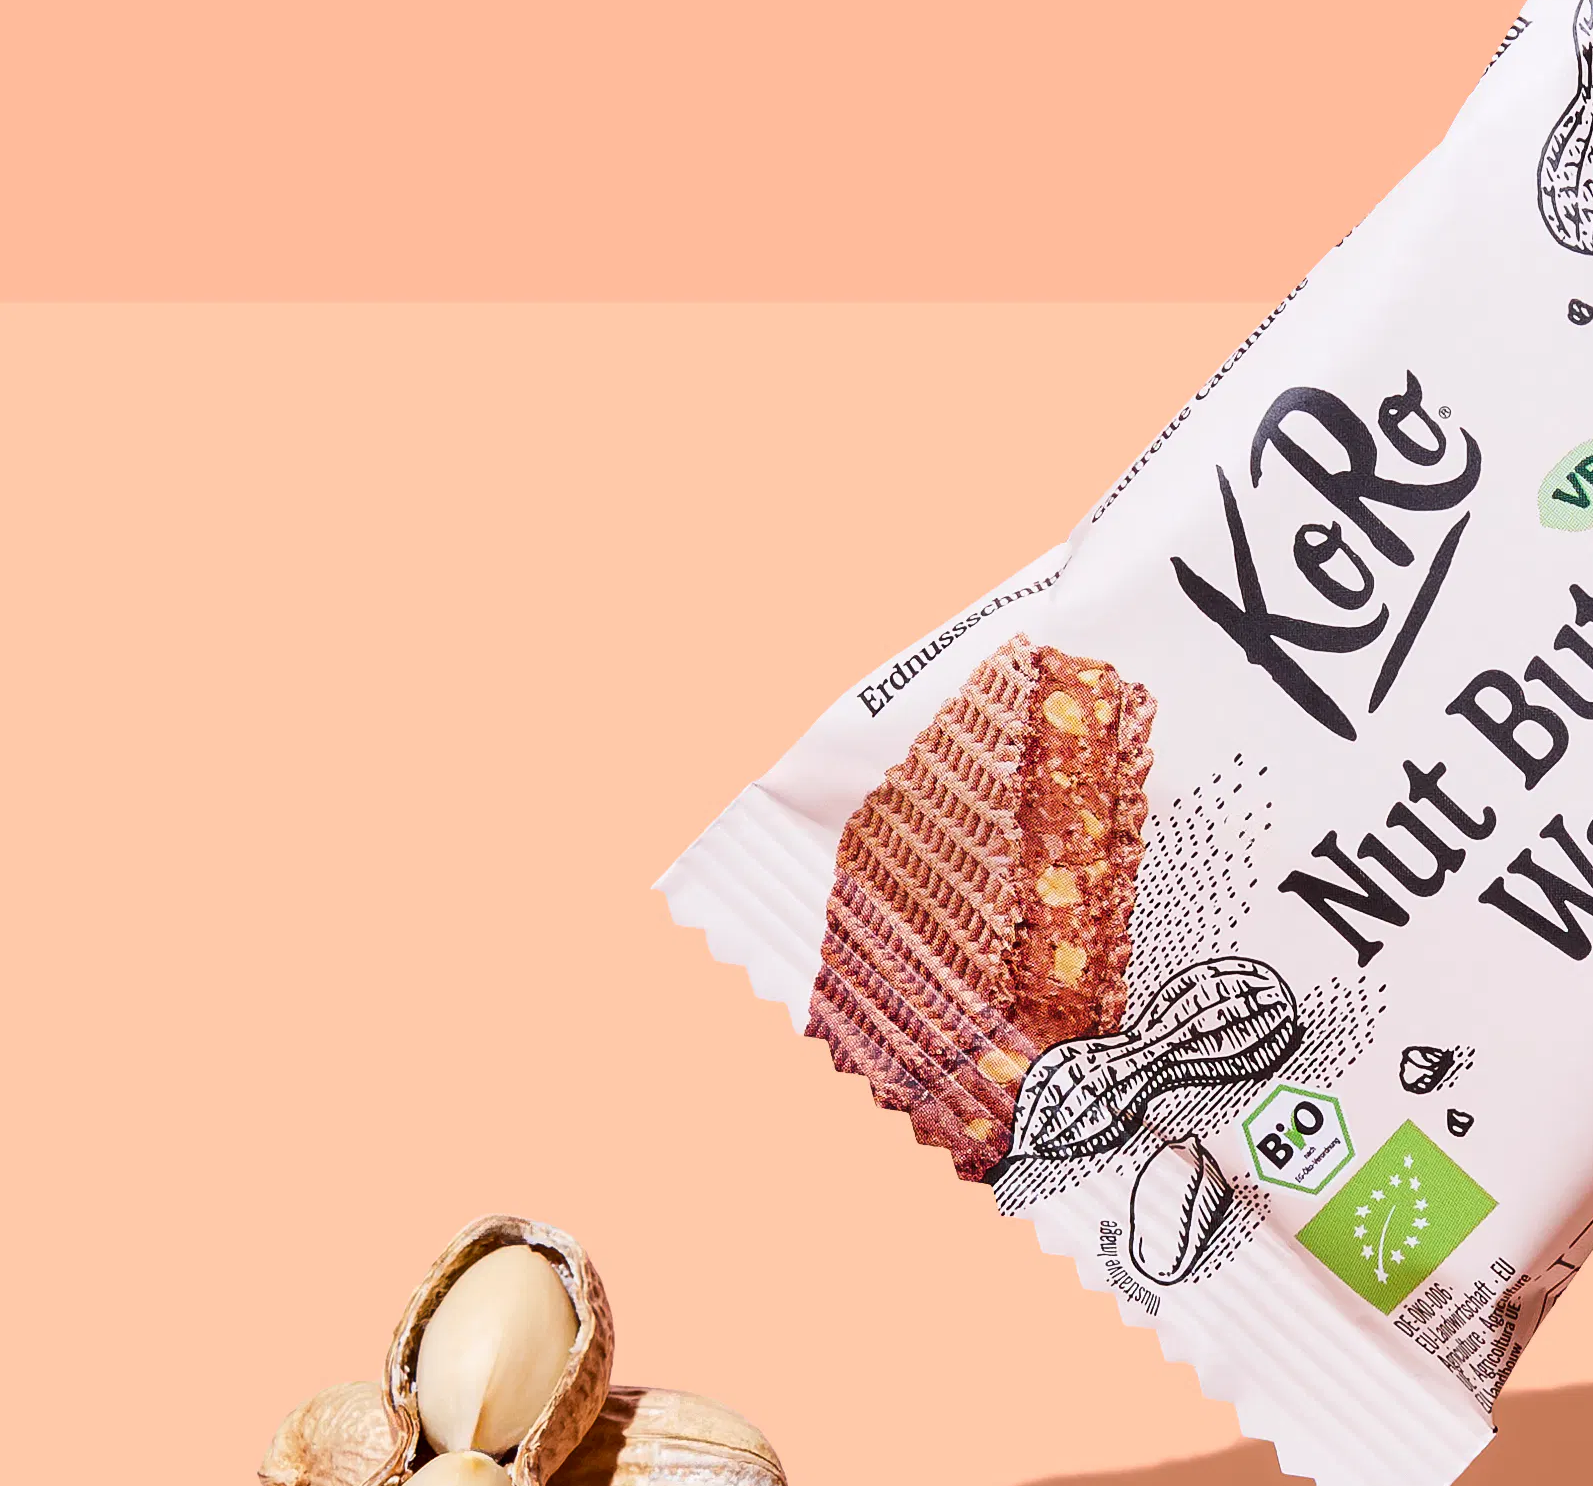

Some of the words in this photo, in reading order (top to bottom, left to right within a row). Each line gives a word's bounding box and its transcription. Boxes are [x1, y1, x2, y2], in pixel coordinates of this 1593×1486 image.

[1278, 760, 1497, 968] Nut
[1097, 1220, 1123, 1257] Image
[1105, 1259, 1161, 1317] Illustrative
[1415, 1279, 1496, 1355] EU-Landwirtschaft
[1490, 1257, 1517, 1282] EU
[1437, 1330, 1486, 1374] Agriculture
[1479, 1273, 1532, 1333] Agriculture
[1469, 1319, 1516, 1383] Agricoltura
[1504, 1300, 1522, 1321] UE
[1489, 1342, 1523, 1400] landbouw
